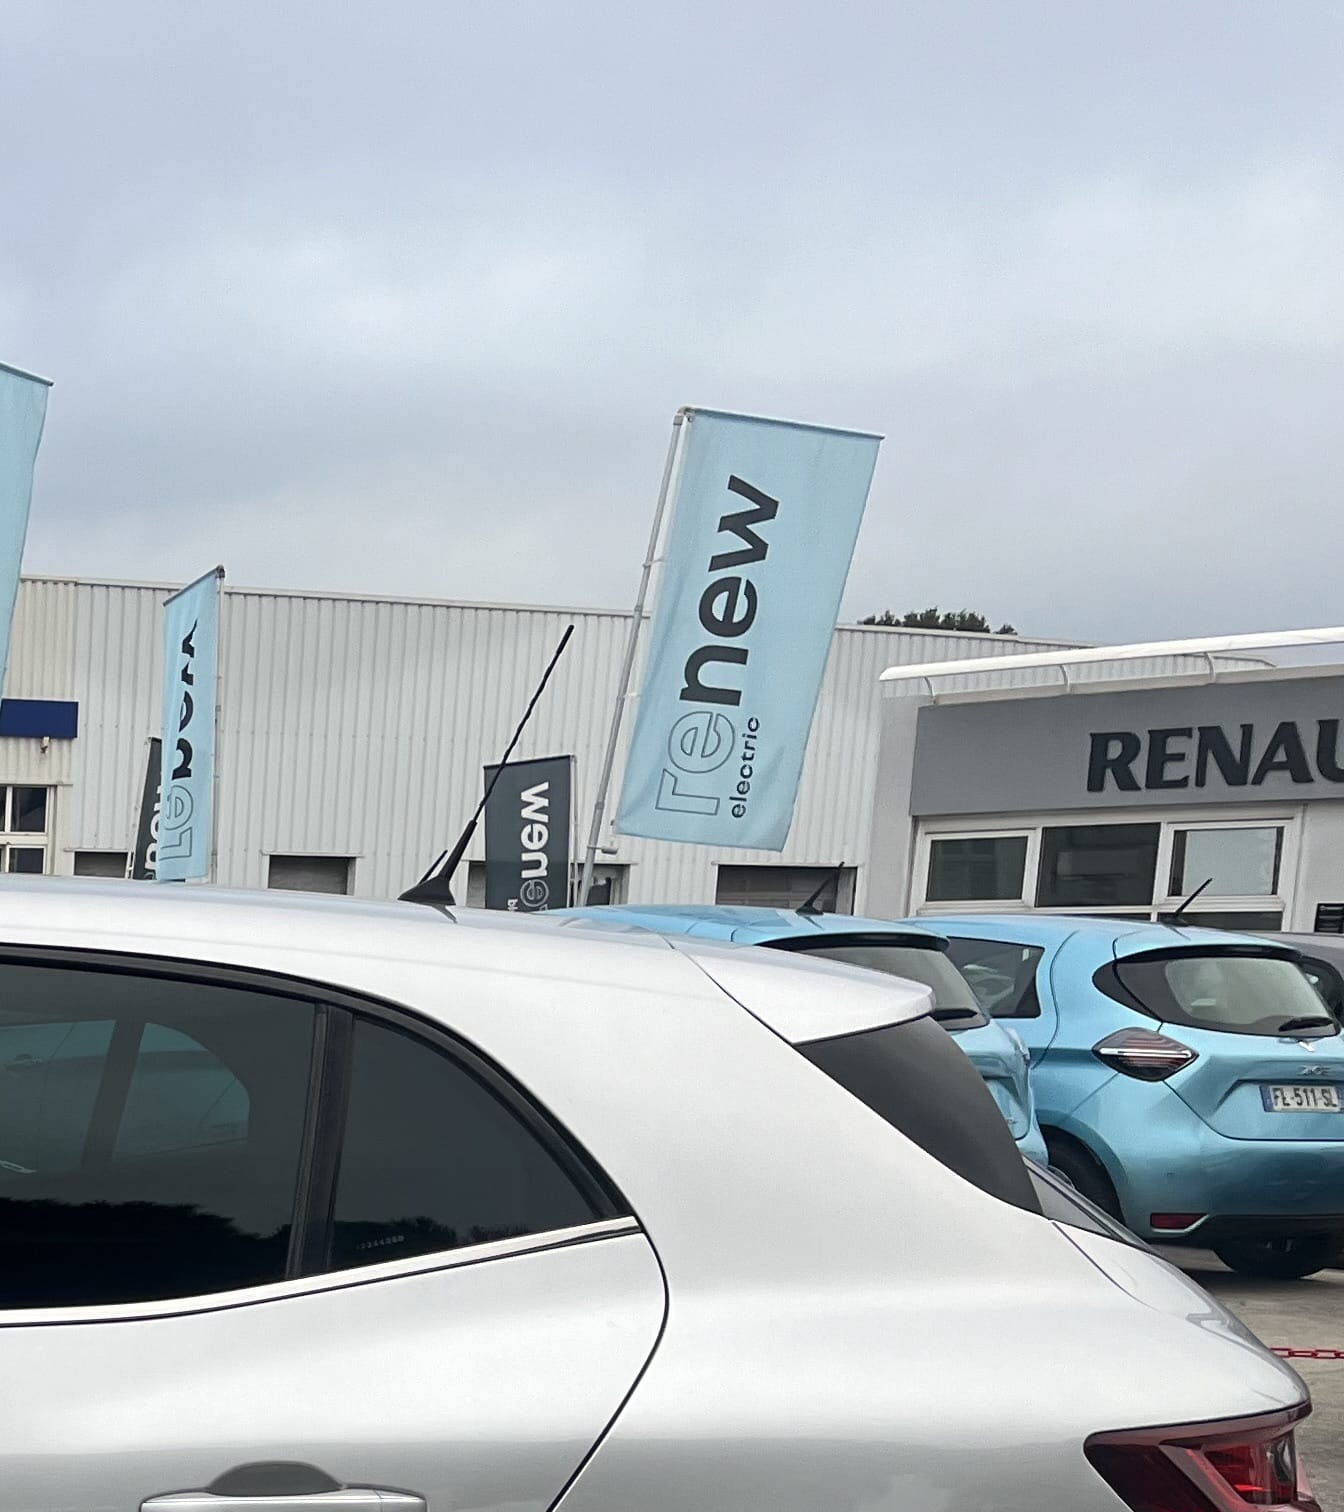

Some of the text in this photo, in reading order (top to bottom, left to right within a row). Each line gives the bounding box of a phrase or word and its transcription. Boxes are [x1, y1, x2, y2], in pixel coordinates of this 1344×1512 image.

[655, 474, 780, 816] renew
[729, 716, 761, 819] electric
[1272, 1087, 1338, 1108] FL-511-SL
